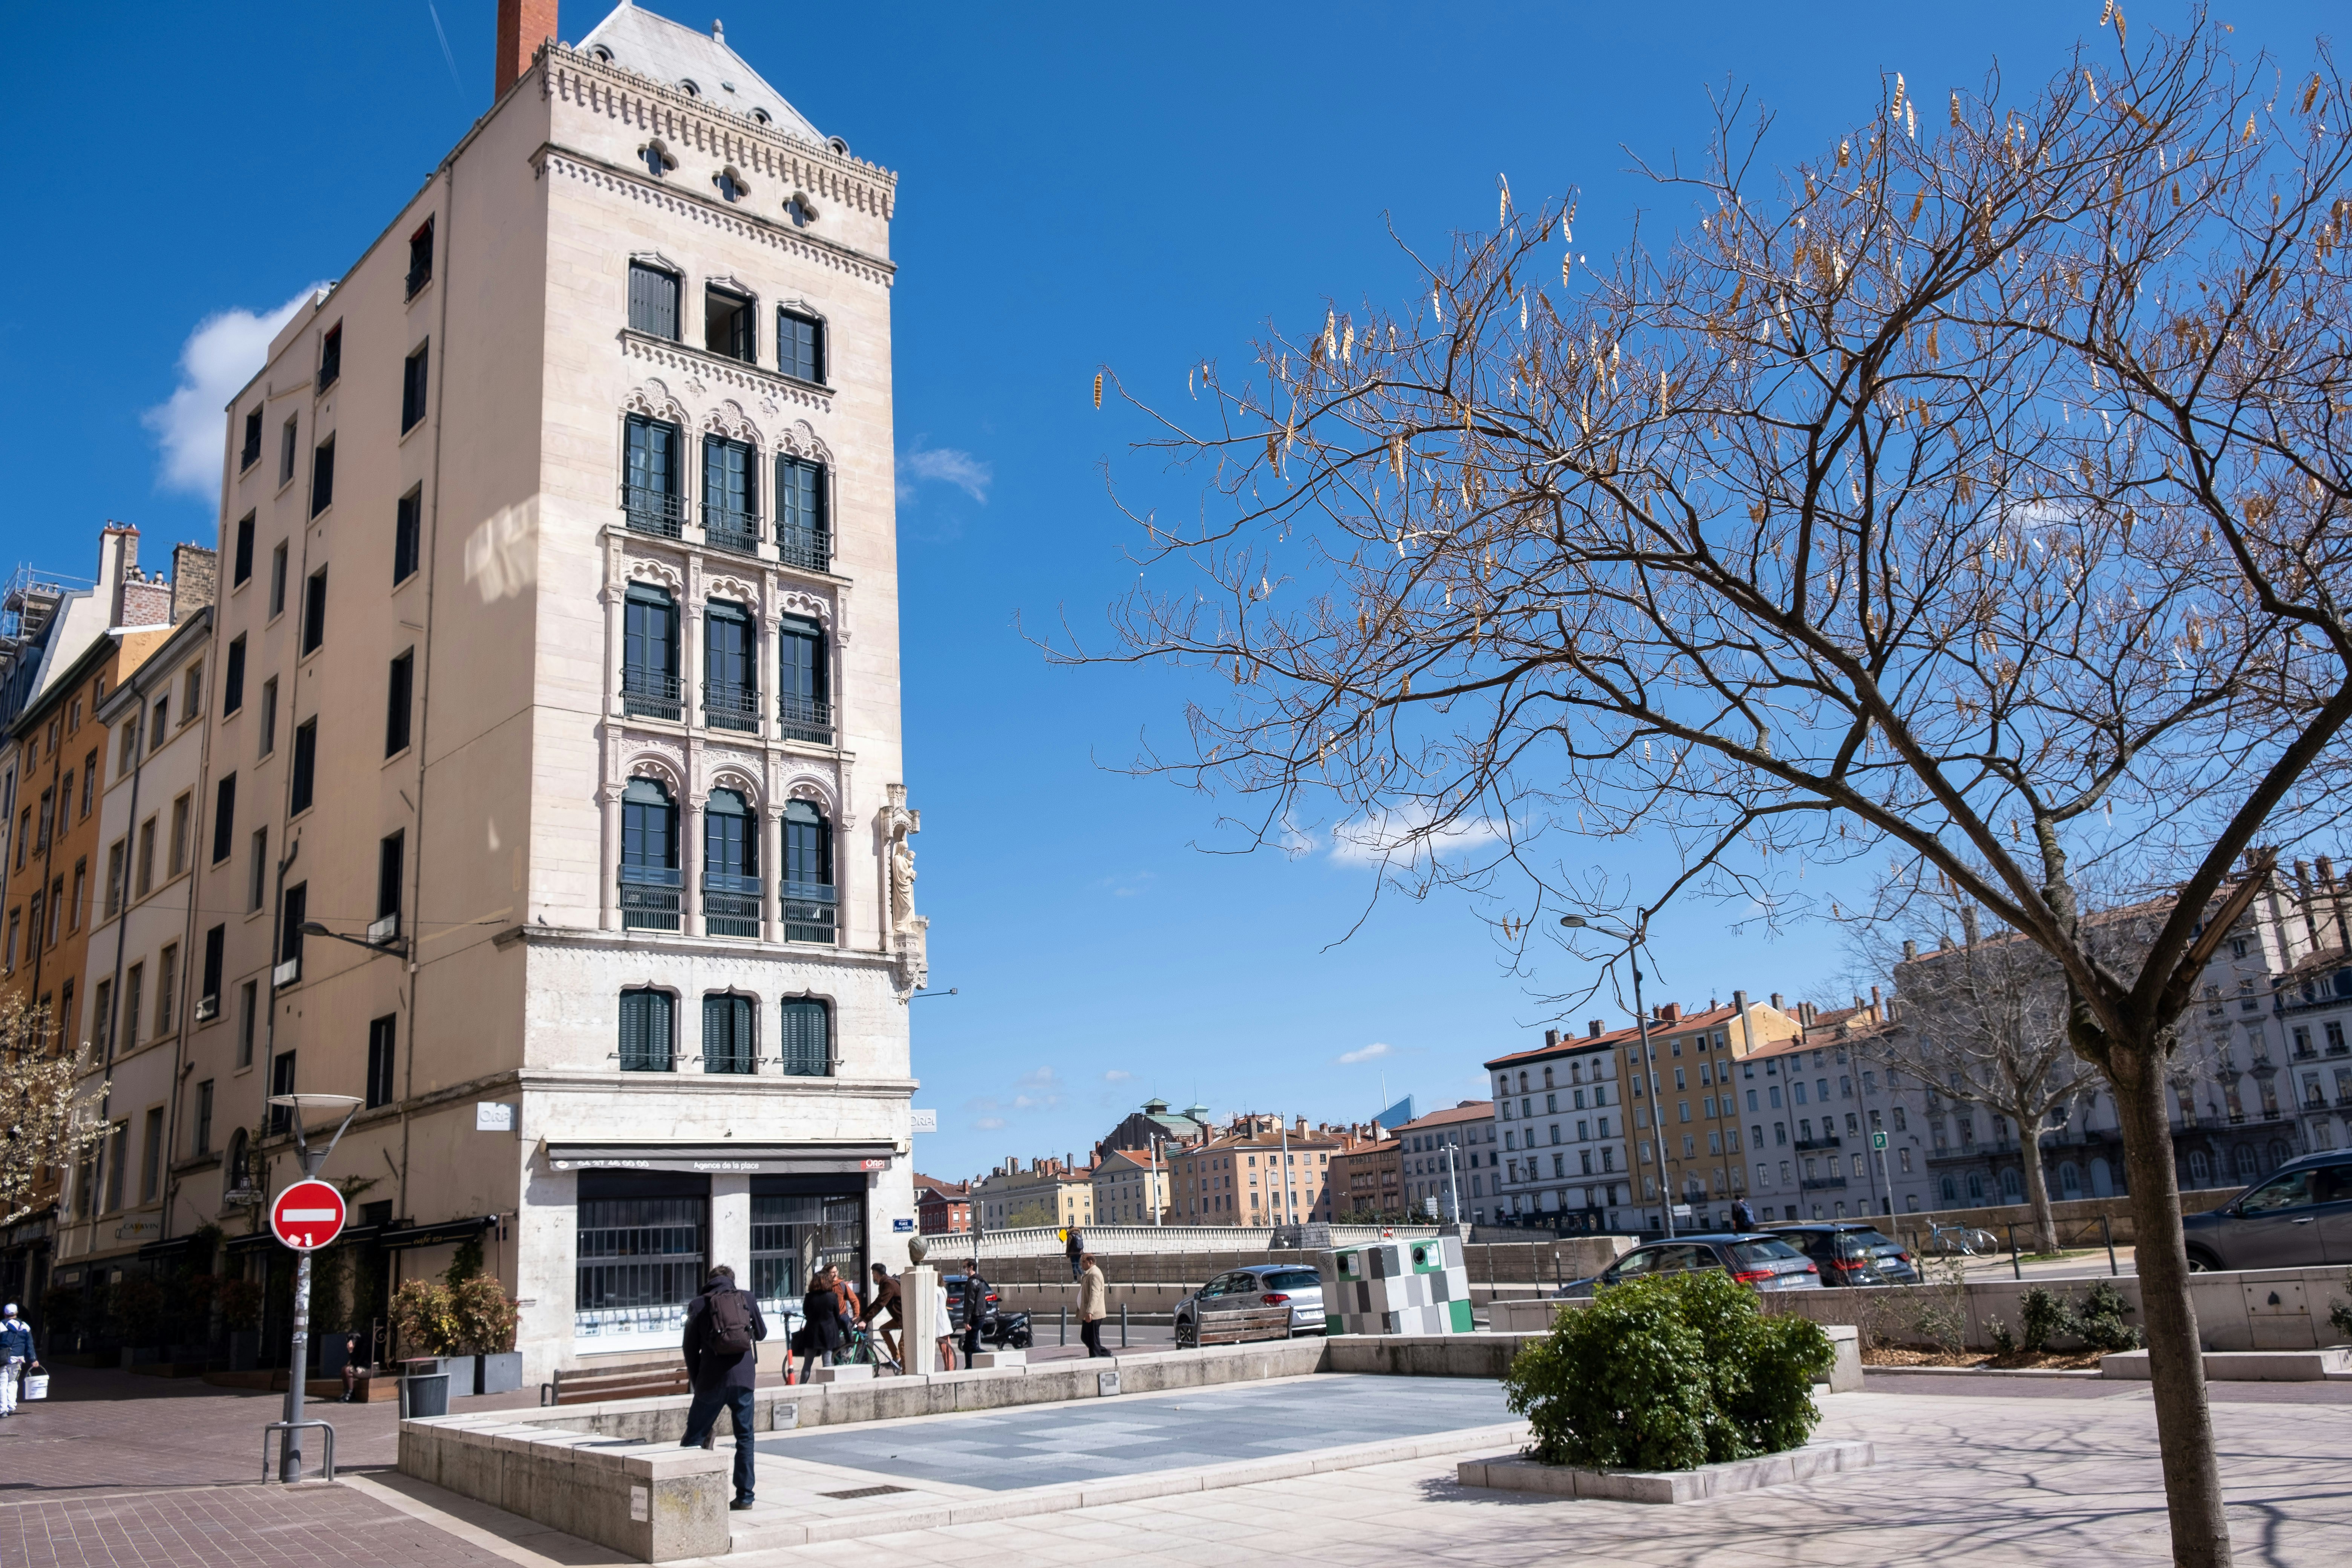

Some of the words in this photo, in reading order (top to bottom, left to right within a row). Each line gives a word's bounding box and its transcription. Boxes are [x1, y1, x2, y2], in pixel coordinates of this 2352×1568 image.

[911, 1115, 935, 1126] ORPI
[694, 1161, 721, 1170] Agence
[740, 1161, 759, 1171] place
